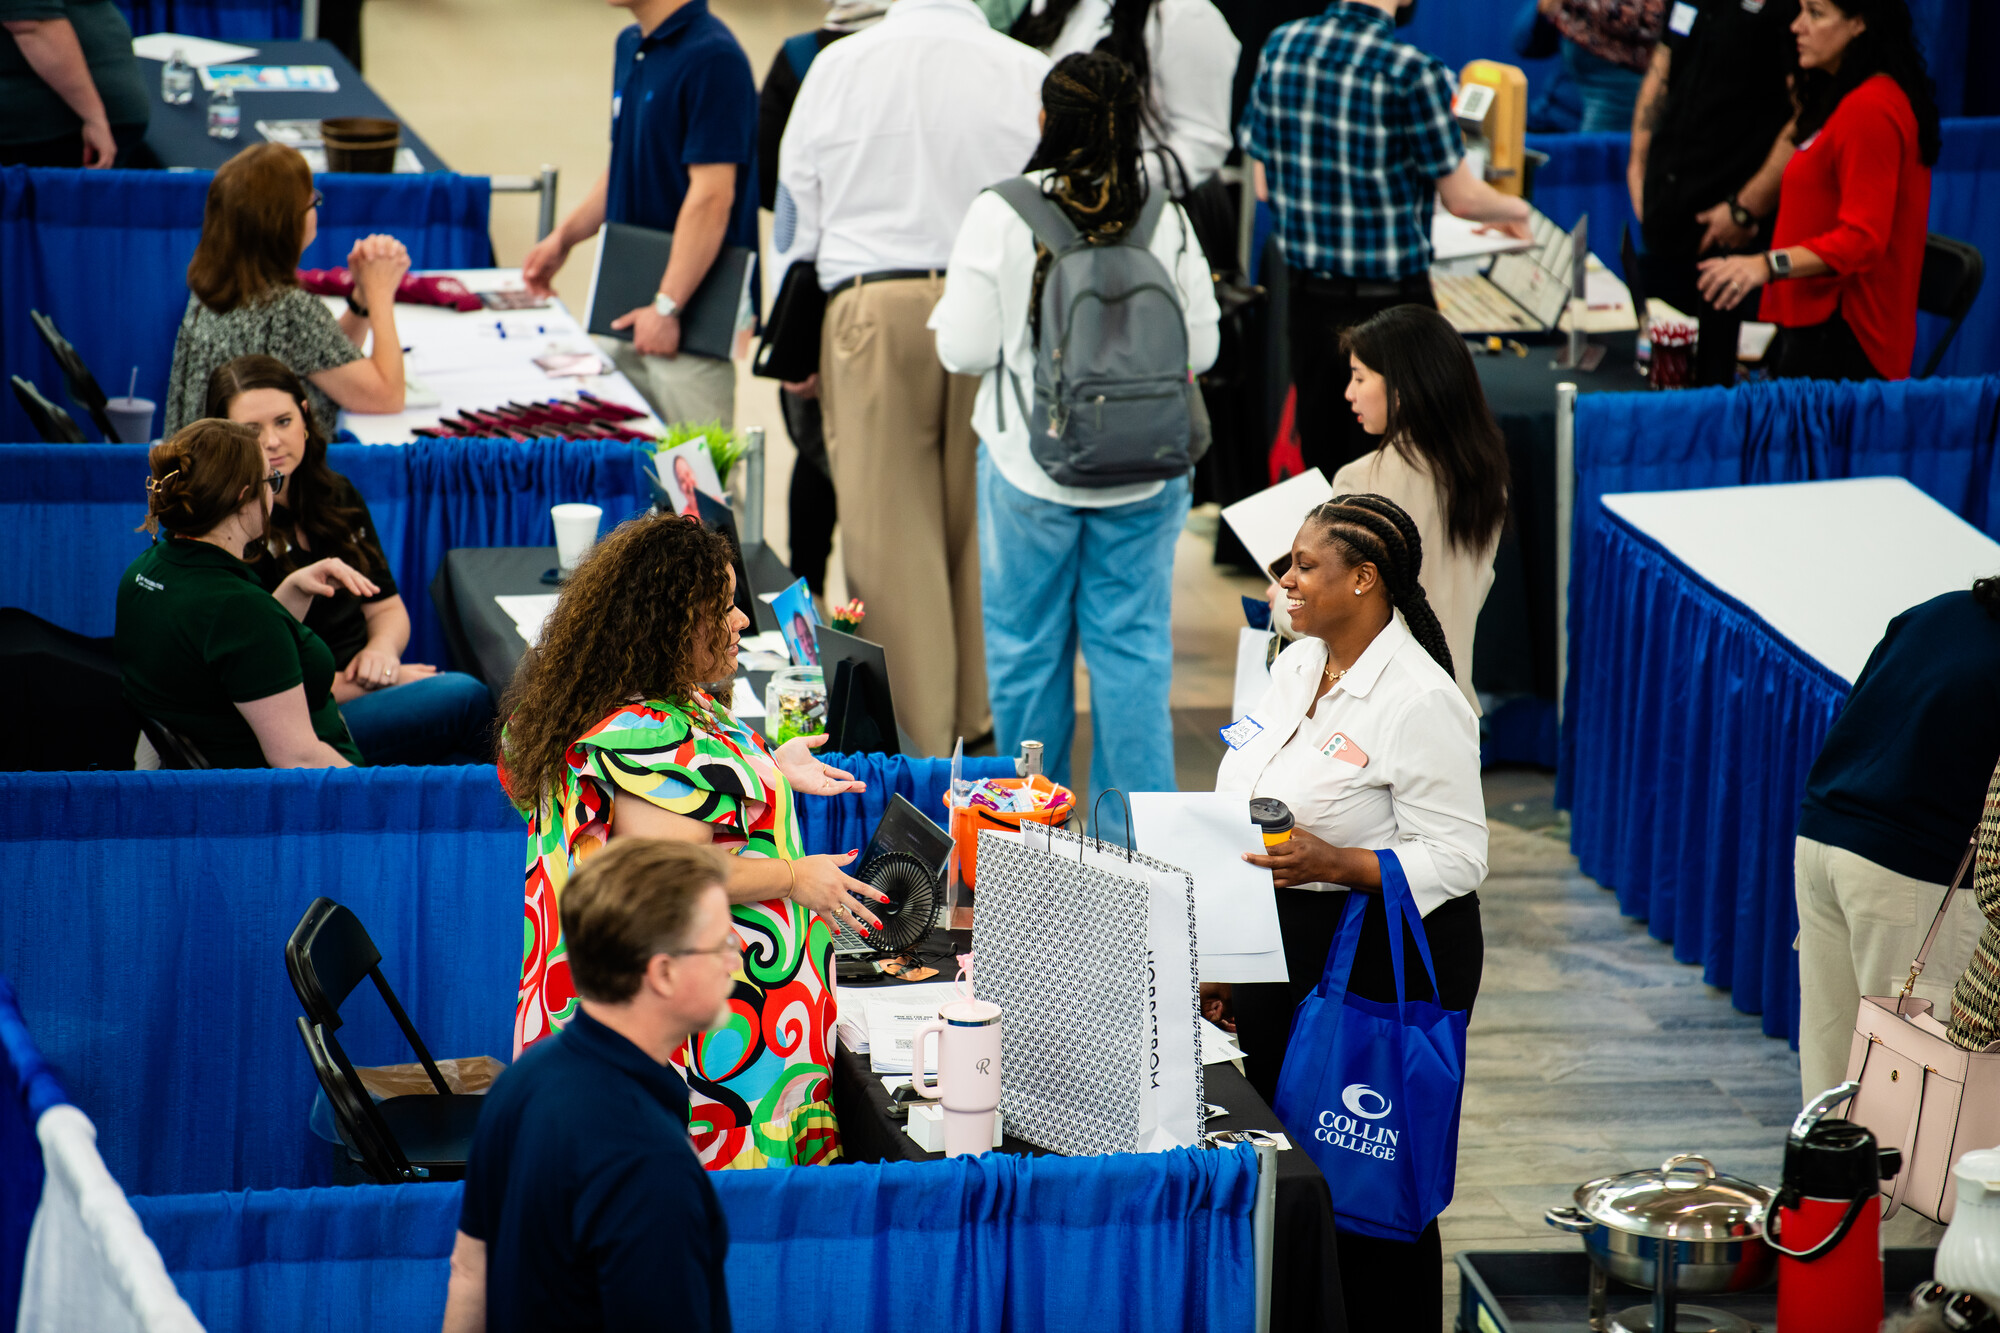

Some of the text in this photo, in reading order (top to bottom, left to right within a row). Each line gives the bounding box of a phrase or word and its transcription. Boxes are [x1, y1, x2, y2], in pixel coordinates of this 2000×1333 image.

[975, 1057, 991, 1075] R
[1314, 1127, 1396, 1161] COLLEGE
[1318, 1110, 1400, 1147] COLLIN
